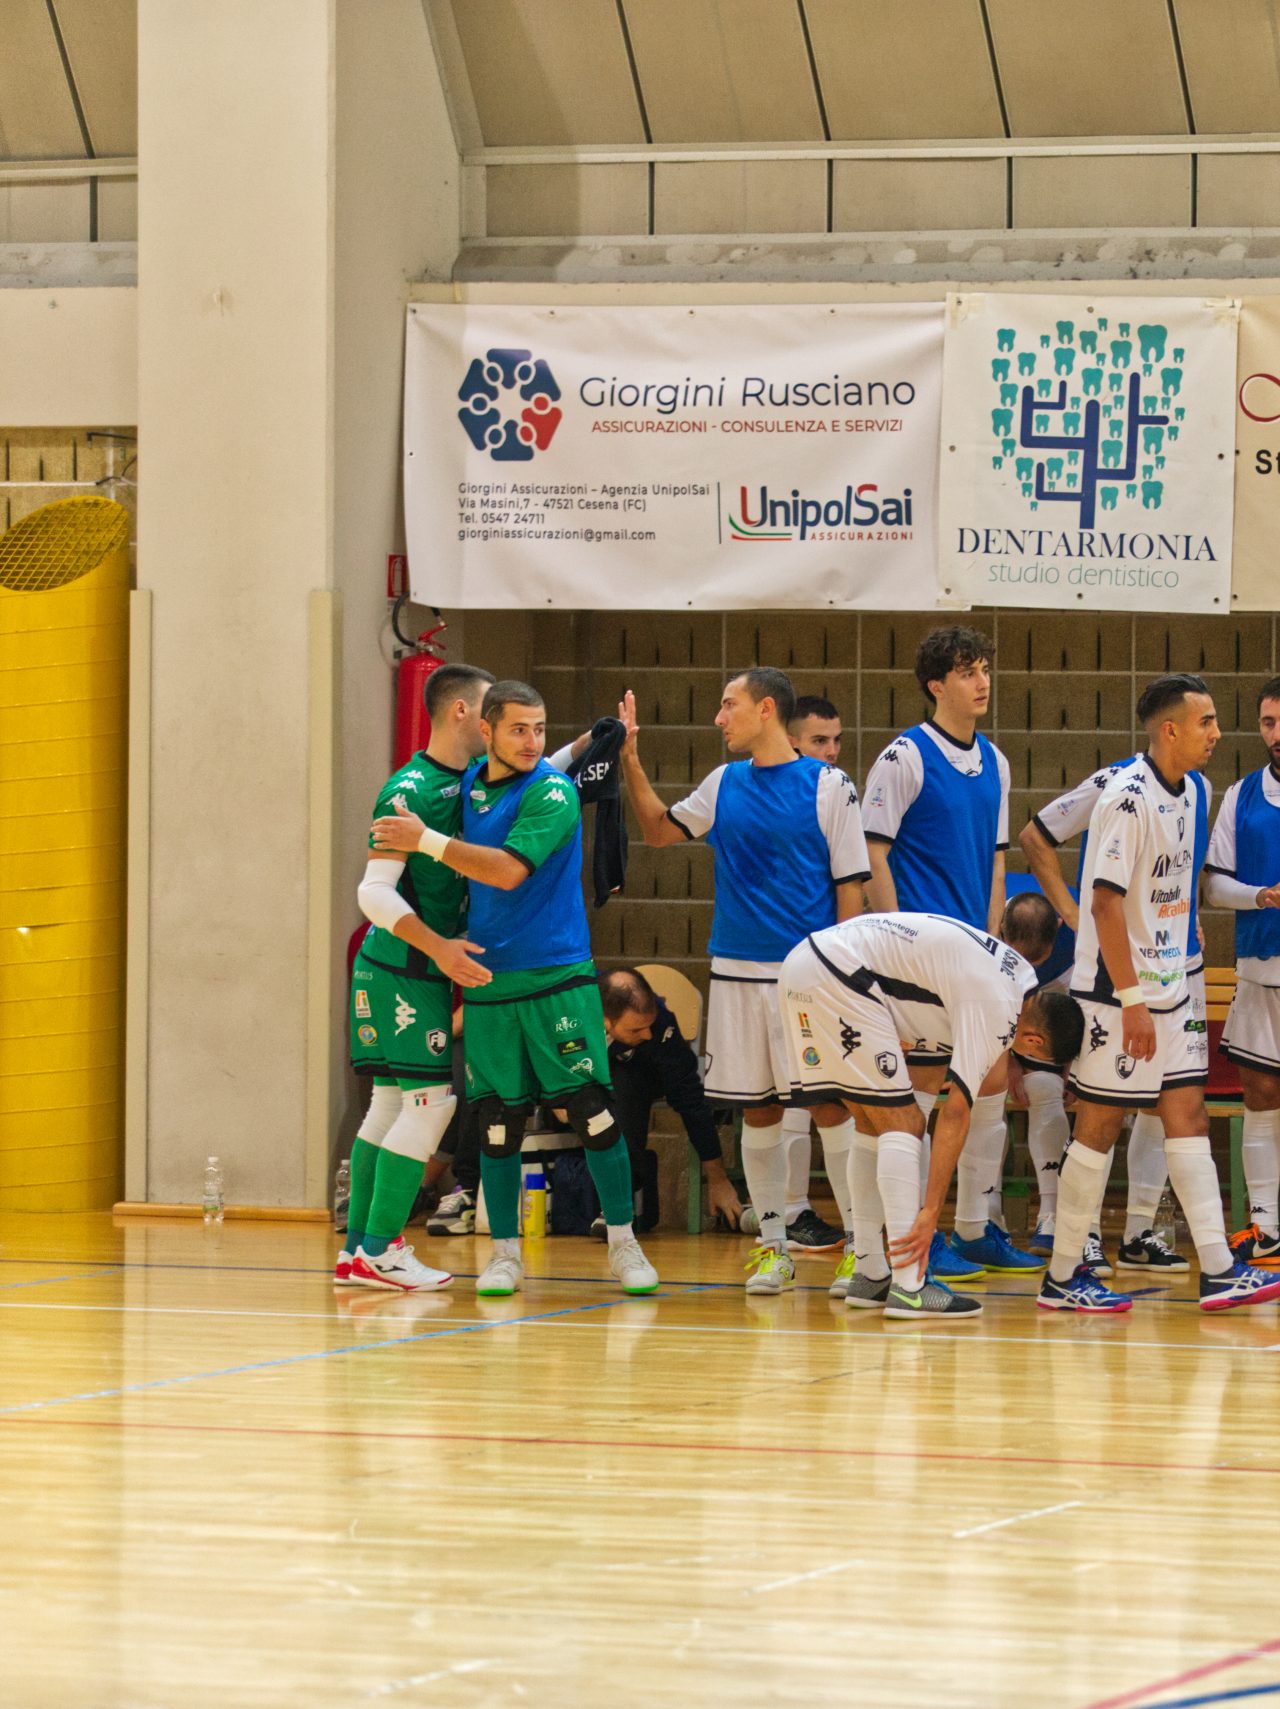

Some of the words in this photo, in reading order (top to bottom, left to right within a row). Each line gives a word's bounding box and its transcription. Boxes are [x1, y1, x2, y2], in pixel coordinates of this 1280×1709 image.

[579, 376, 725, 415] Giorgini
[742, 374, 916, 407] Rusciano
[591, 420, 707, 433] ASSICURAZIONI
[720, 420, 829, 434] CONSULENZA
[831, 420, 839, 433] E
[844, 419, 903, 433] SERVIZI
[458, 482, 507, 497] Giorgini
[511, 483, 588, 495] Assicurazioni
[601, 484, 648, 498] Agenzia
[652, 483, 710, 496] UnipolSai
[458, 498, 476, 509] Via
[480, 498, 530, 511] Masini,7
[543, 499, 574, 510] 47521
[577, 499, 619, 510] Cesena
[623, 498, 647, 512] (FC)
[740, 483, 913, 541] UnipolSai
[458, 512, 478, 523] Tel.
[481, 512, 510, 524] 0547
[513, 513, 545, 524] 24711
[458, 528, 656, 541] giorginiassicurazioni@gmail.com
[810, 530, 914, 541] ASSICURAZIONI
[957, 527, 1218, 562] DENTARMONIA
[988, 561, 1060, 585] studio
[1067, 564, 1180, 589] dentistico
